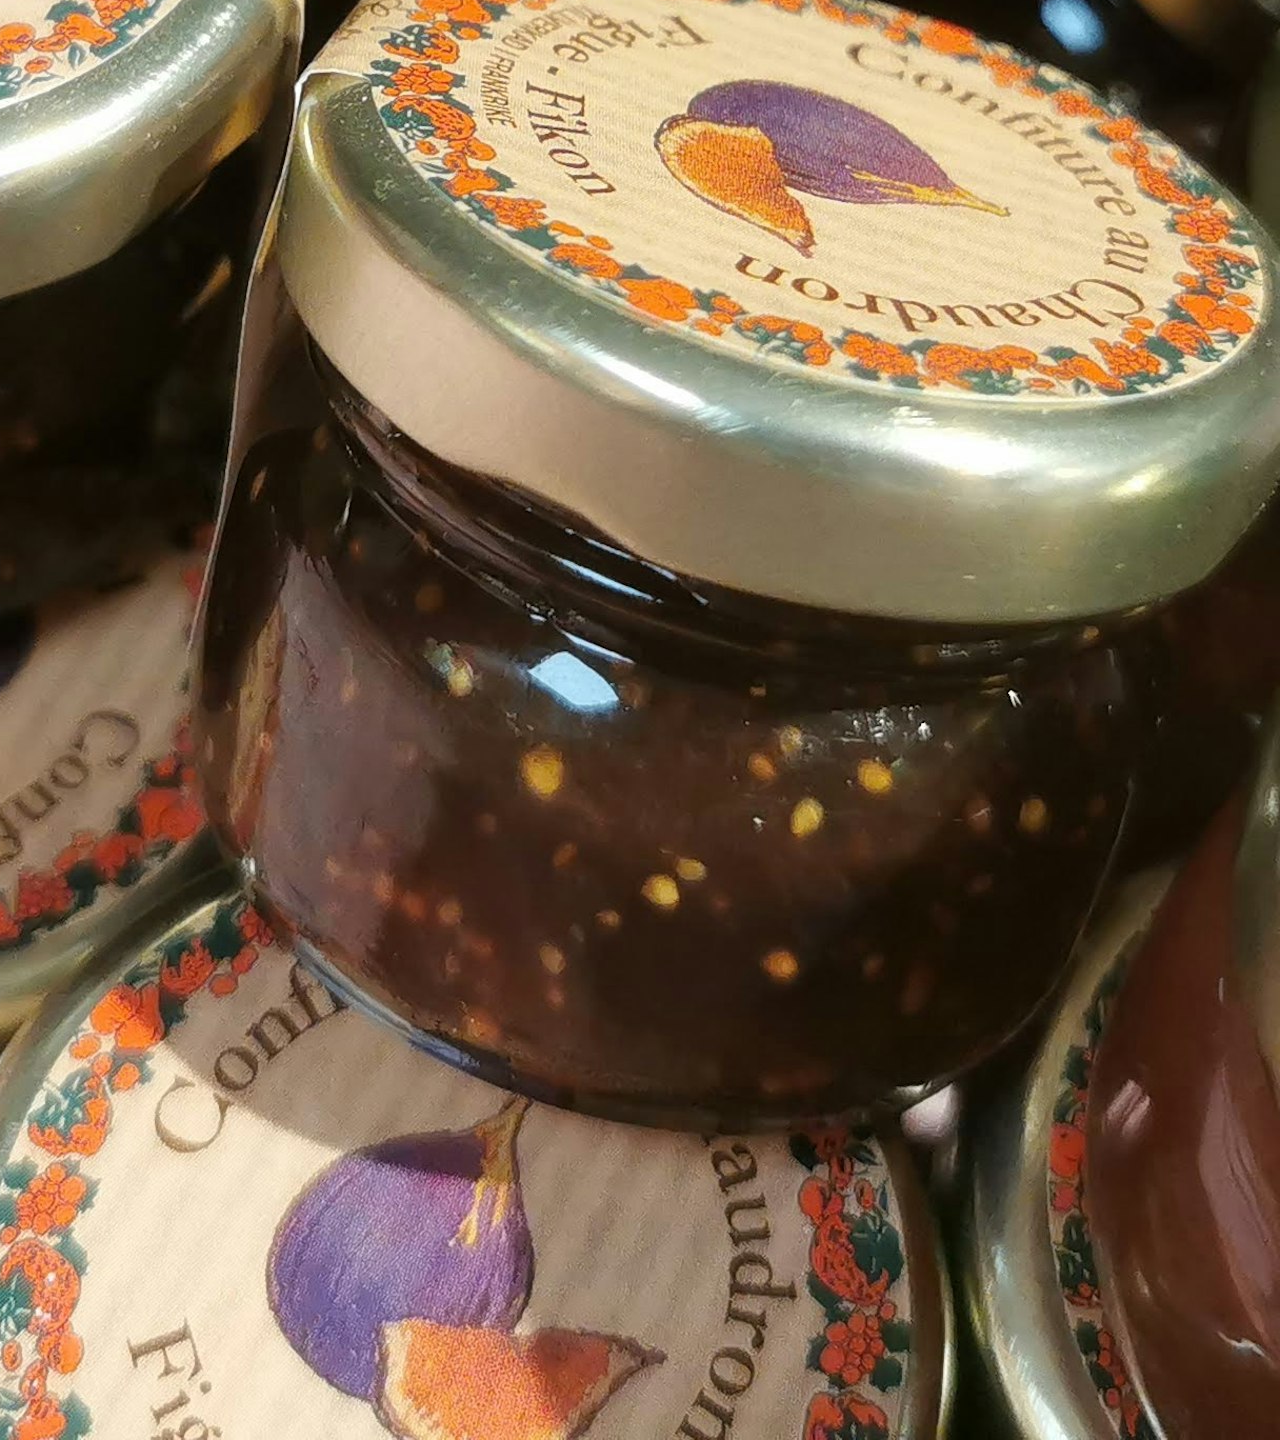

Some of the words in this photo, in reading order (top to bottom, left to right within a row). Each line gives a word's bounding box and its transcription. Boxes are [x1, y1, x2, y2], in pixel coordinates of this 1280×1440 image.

[553, 9, 706, 62] Figue
[481, 54, 518, 129] FRANKRIKE
[846, 42, 1138, 217] Confiture
[526, 81, 616, 197] Fikon
[1116, 224, 1150, 275] au
[735, 253, 1148, 334] Chaudron
[676, 1135, 797, 1440] audron
